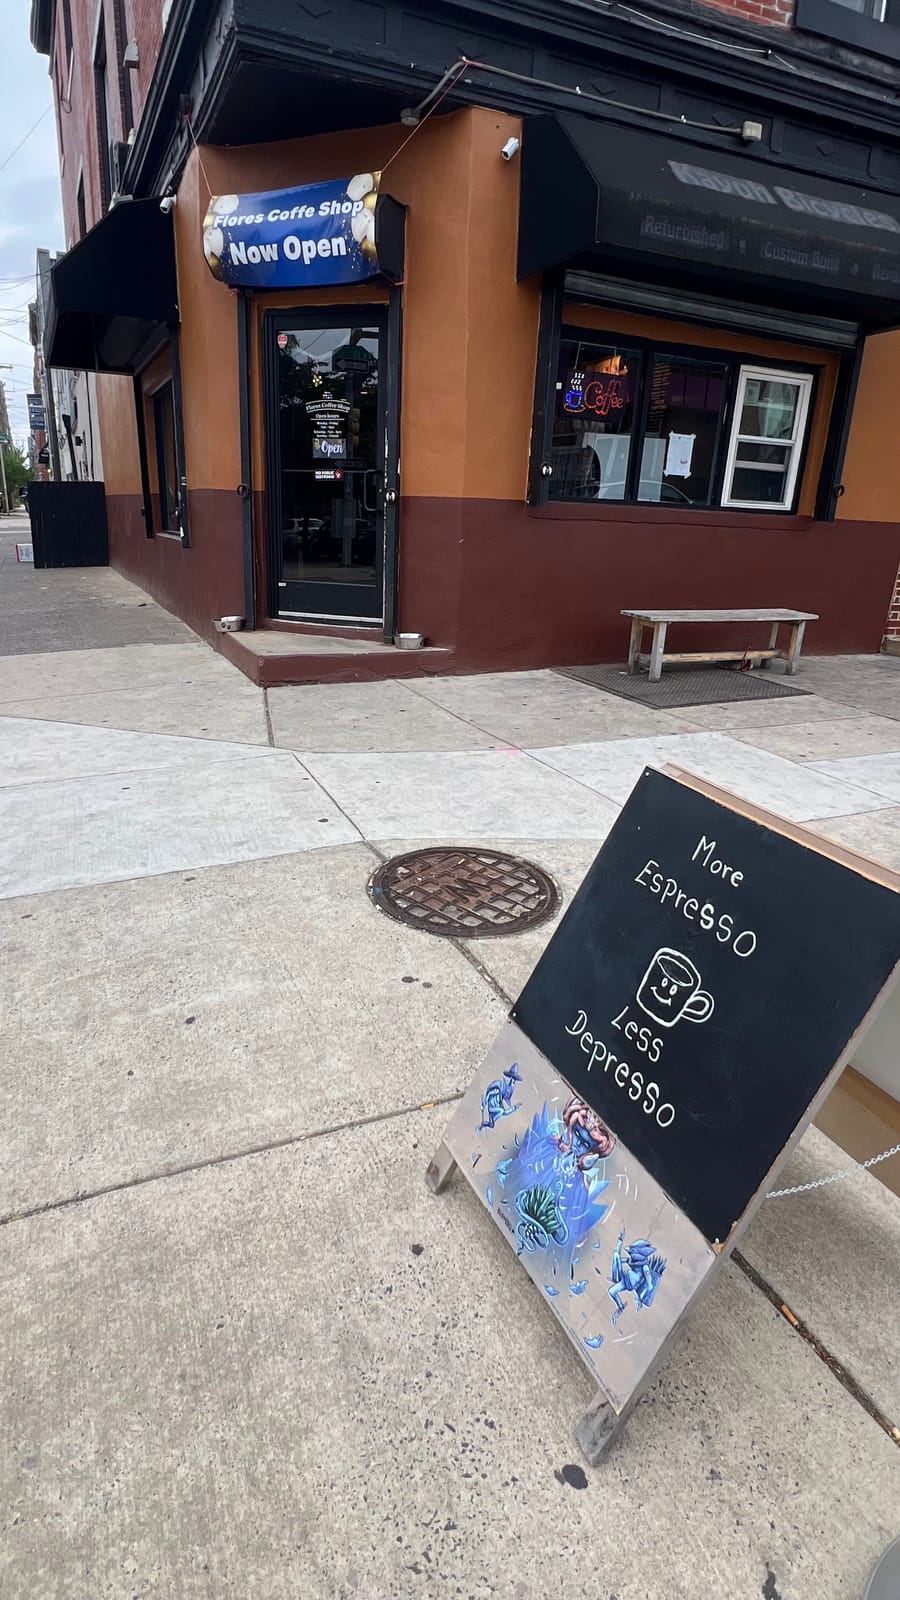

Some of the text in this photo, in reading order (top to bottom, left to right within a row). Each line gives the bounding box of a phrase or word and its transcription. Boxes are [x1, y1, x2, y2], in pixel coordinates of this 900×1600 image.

[213, 199, 365, 229] Flores Coffe Shop
[773, 186, 900, 233] Bicycles
[644, 214, 726, 250] Refurbished
[230, 235, 348, 266] Now Open
[763, 239, 810, 263] Custom
[584, 379, 624, 415] Coffee
[320, 440, 344, 457] Open
[691, 835, 745, 888] More
[610, 1005, 664, 1062] Less
